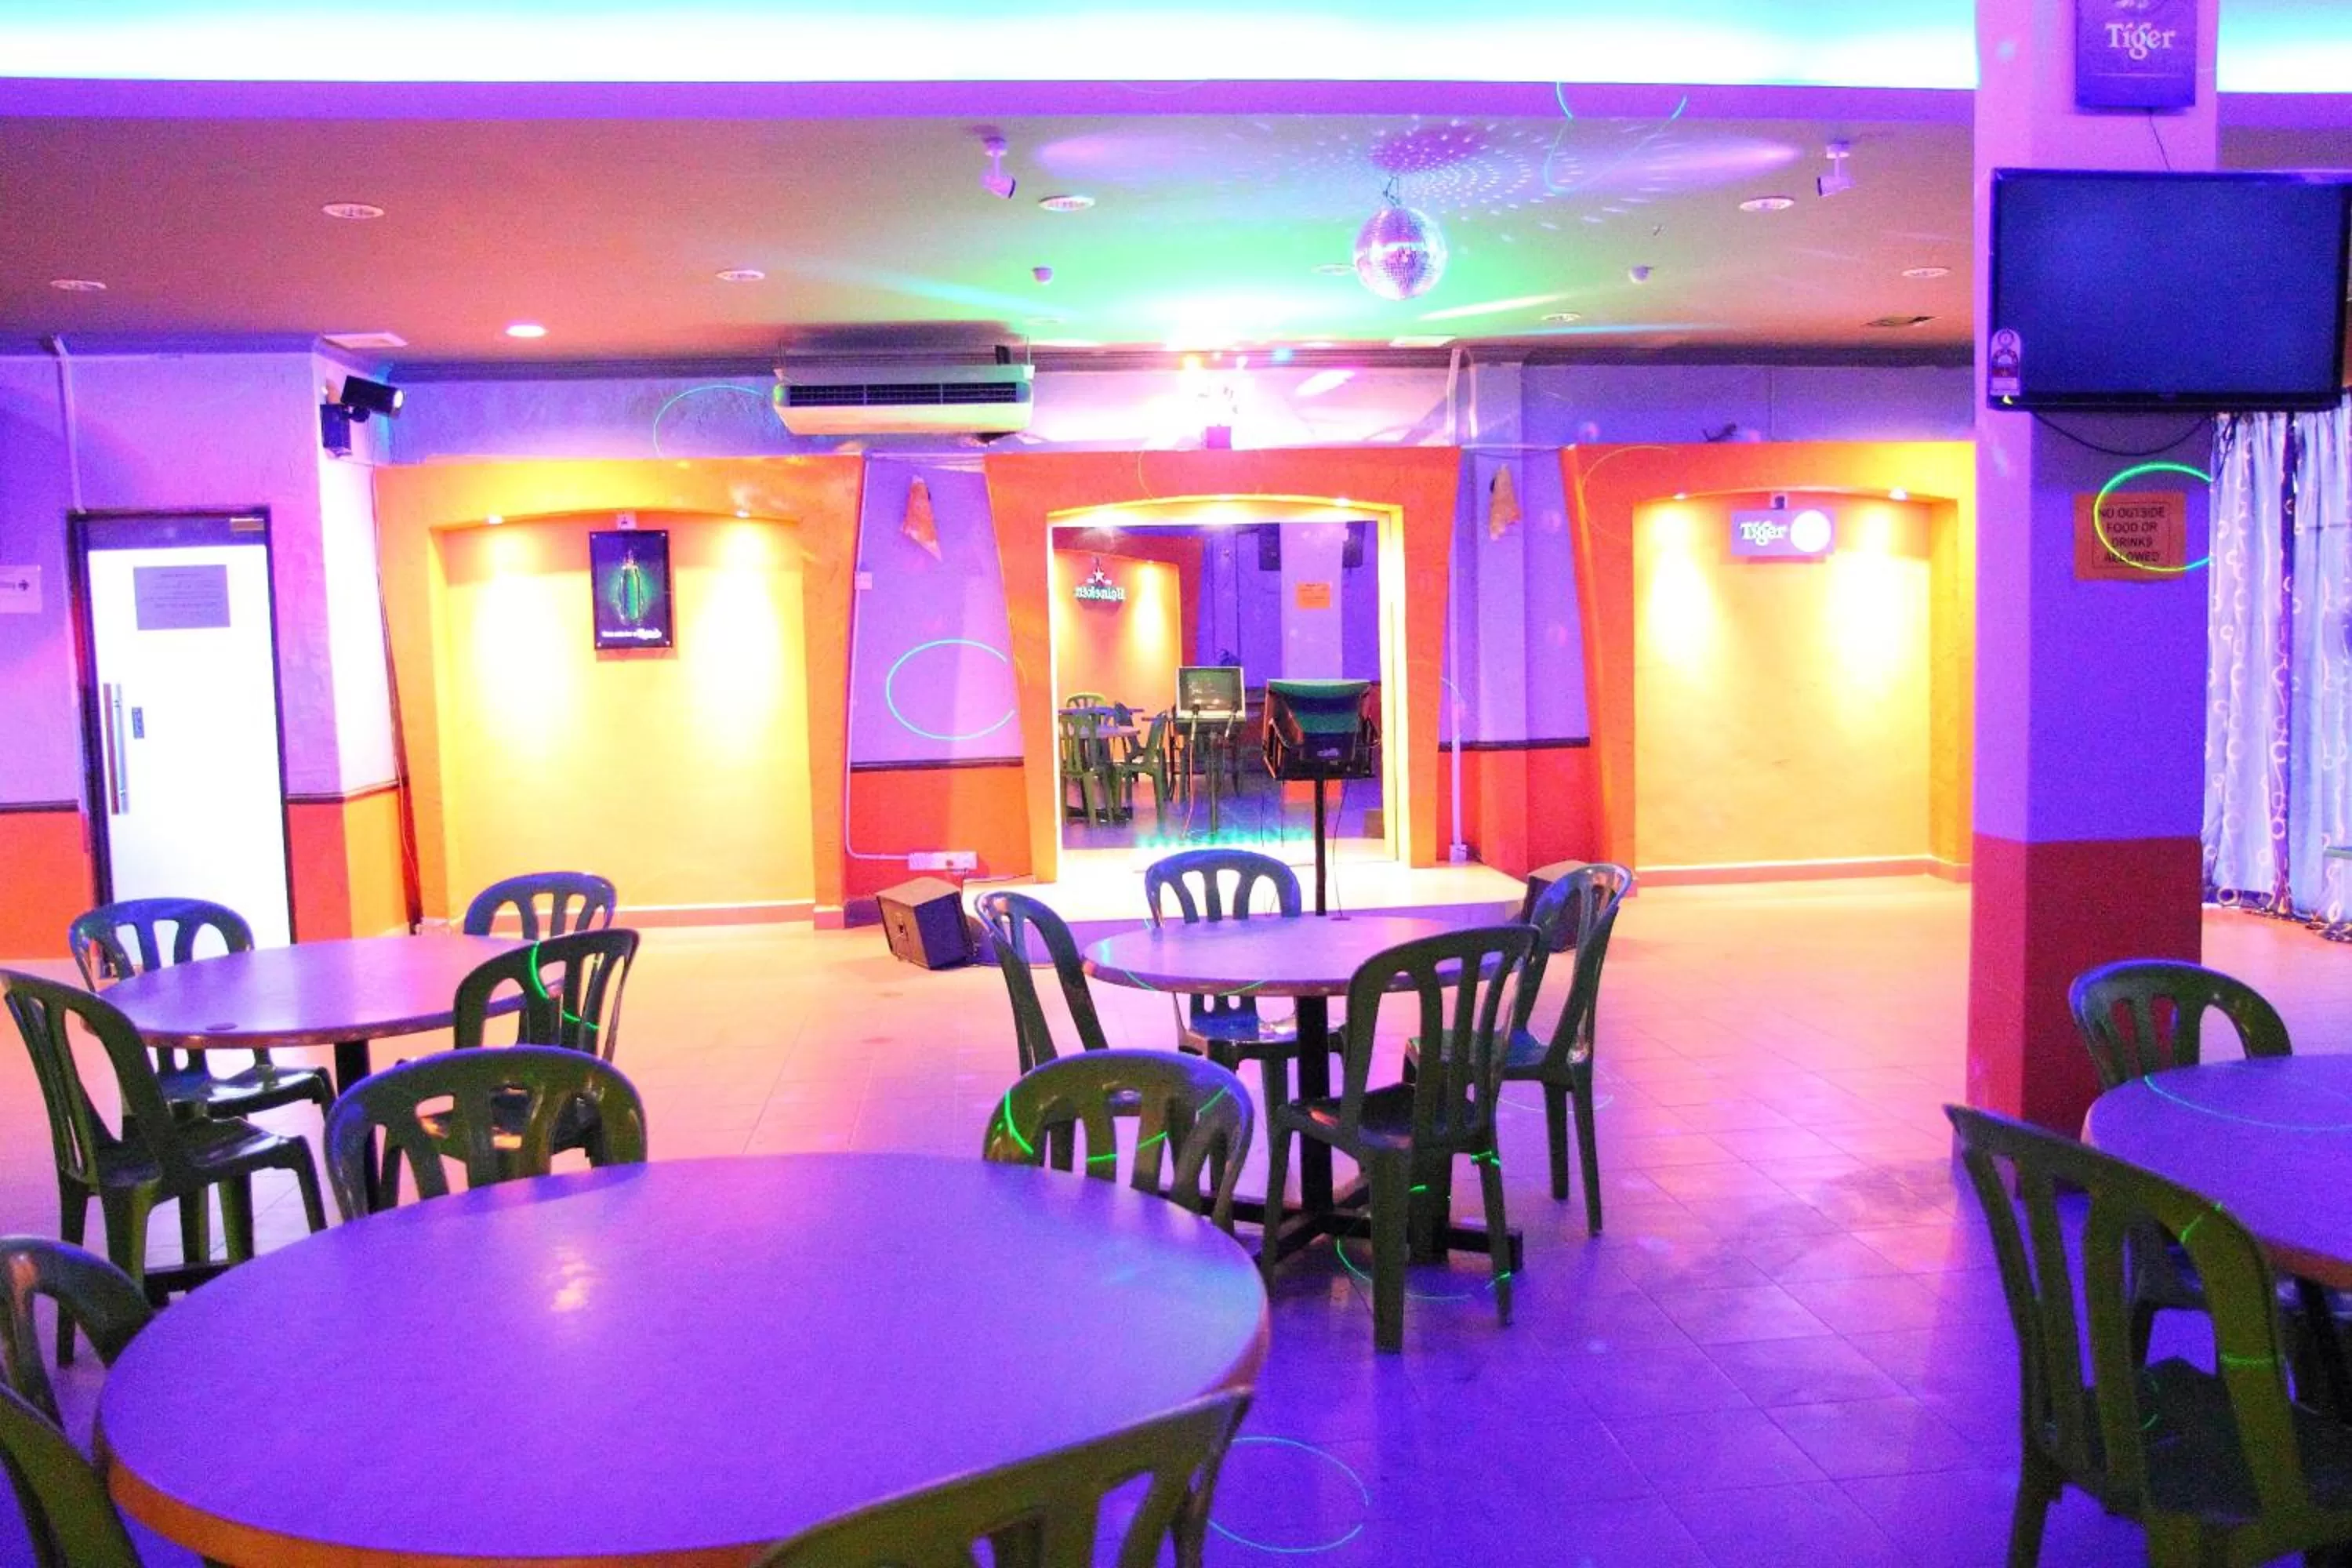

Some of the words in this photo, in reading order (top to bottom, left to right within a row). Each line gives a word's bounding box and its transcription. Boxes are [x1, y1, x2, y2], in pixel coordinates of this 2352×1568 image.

[2105, 23, 2176, 60] Tiger
[2118, 506, 2165, 518] OUTSIDE
[2107, 522, 2137, 533] FOOD
[2141, 521, 2158, 532] OR
[1740, 521, 1786, 546] Tiger
[2111, 537, 2153, 547] DRINKS
